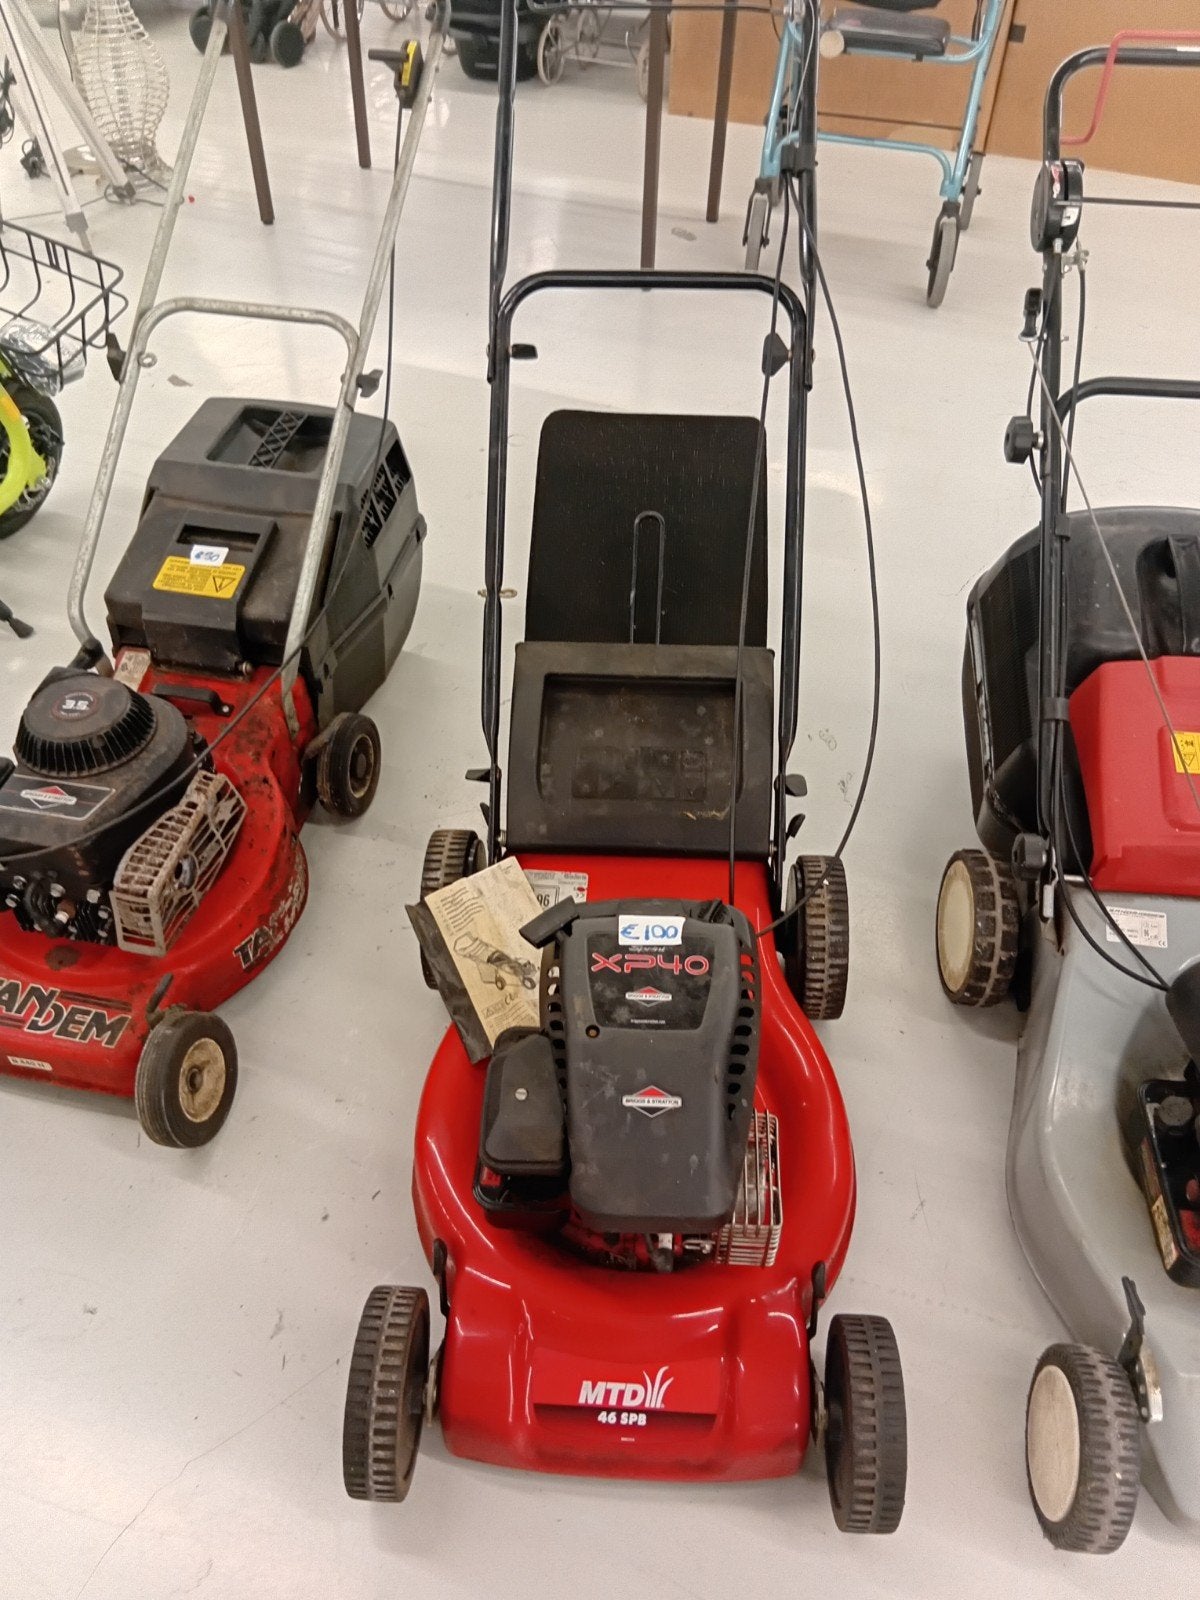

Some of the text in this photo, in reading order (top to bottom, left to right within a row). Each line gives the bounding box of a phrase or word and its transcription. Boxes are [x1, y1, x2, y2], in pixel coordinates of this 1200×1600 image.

[591, 952, 710, 976] XP40
[0, 977, 132, 1049] ANDEM
[578, 1380, 646, 1408] MTD
[597, 1411, 647, 1426] 46 SPB
